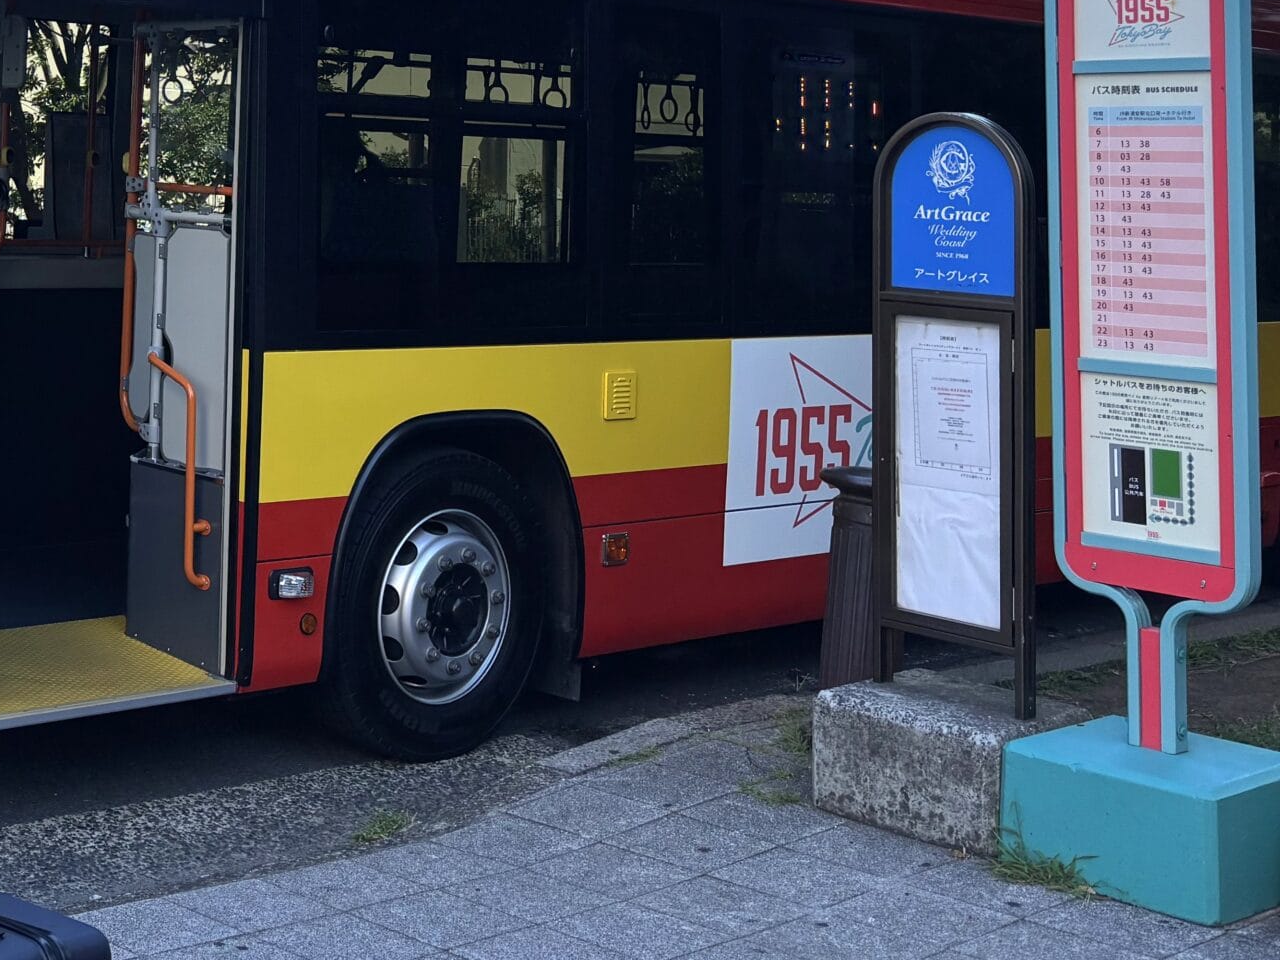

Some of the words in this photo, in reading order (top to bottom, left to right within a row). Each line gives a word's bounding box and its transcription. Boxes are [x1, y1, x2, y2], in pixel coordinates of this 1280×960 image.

[1092, 86, 1140, 95] バス時刻表
[913, 205, 990, 222] ArtGrace
[928, 224, 977, 240] Wedding
[935, 236, 965, 247] Coast
[914, 268, 989, 283] アートグレイス
[1094, 378, 1206, 394] シャトルバスをお待ちのお客様へ
[756, 404, 852, 496] 1955
